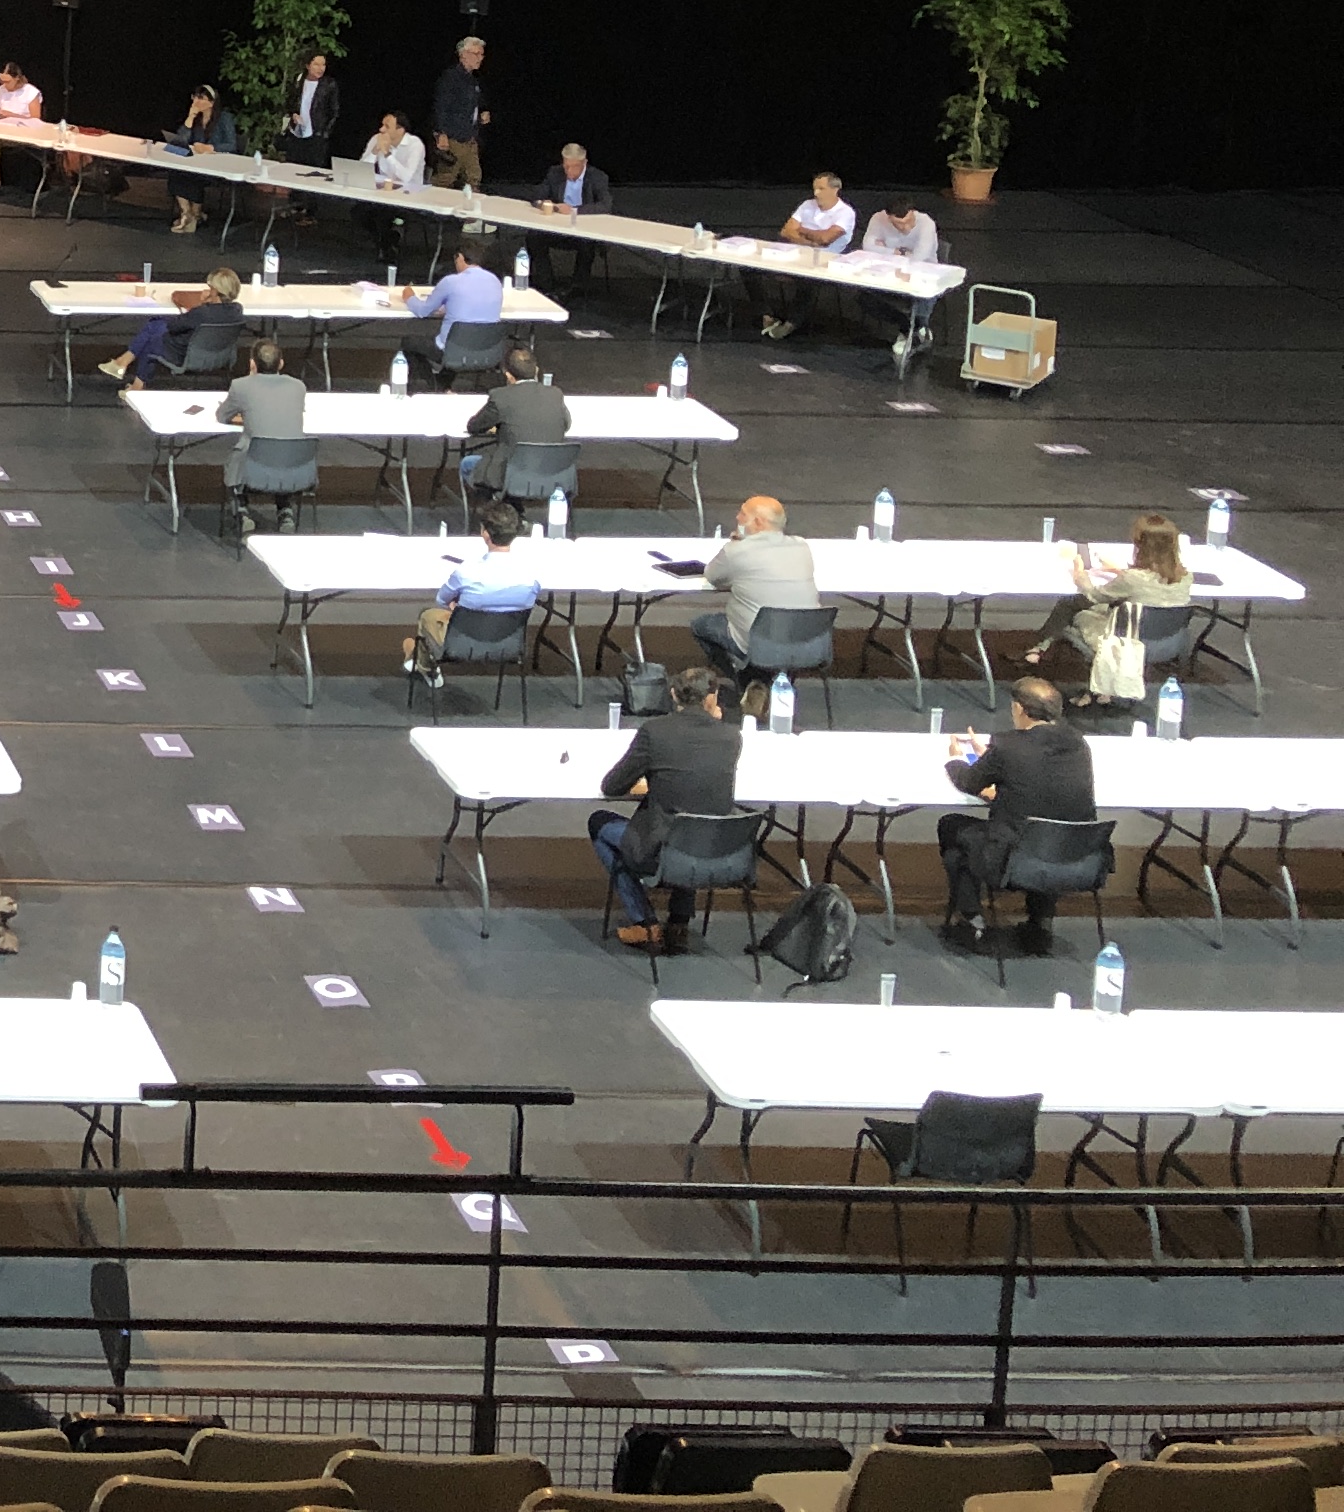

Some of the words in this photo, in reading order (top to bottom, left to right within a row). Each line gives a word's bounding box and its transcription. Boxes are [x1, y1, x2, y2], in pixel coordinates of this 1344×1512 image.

[4, 511, 35, 523] H
[45, 560, 59, 573] I
[72, 613, 90, 627] J
[103, 671, 139, 686] K
[153, 736, 182, 752] L
[197, 807, 239, 825] M
[249, 886, 297, 906] N
[313, 977, 358, 999] O
[460, 1193, 517, 1223] Q
